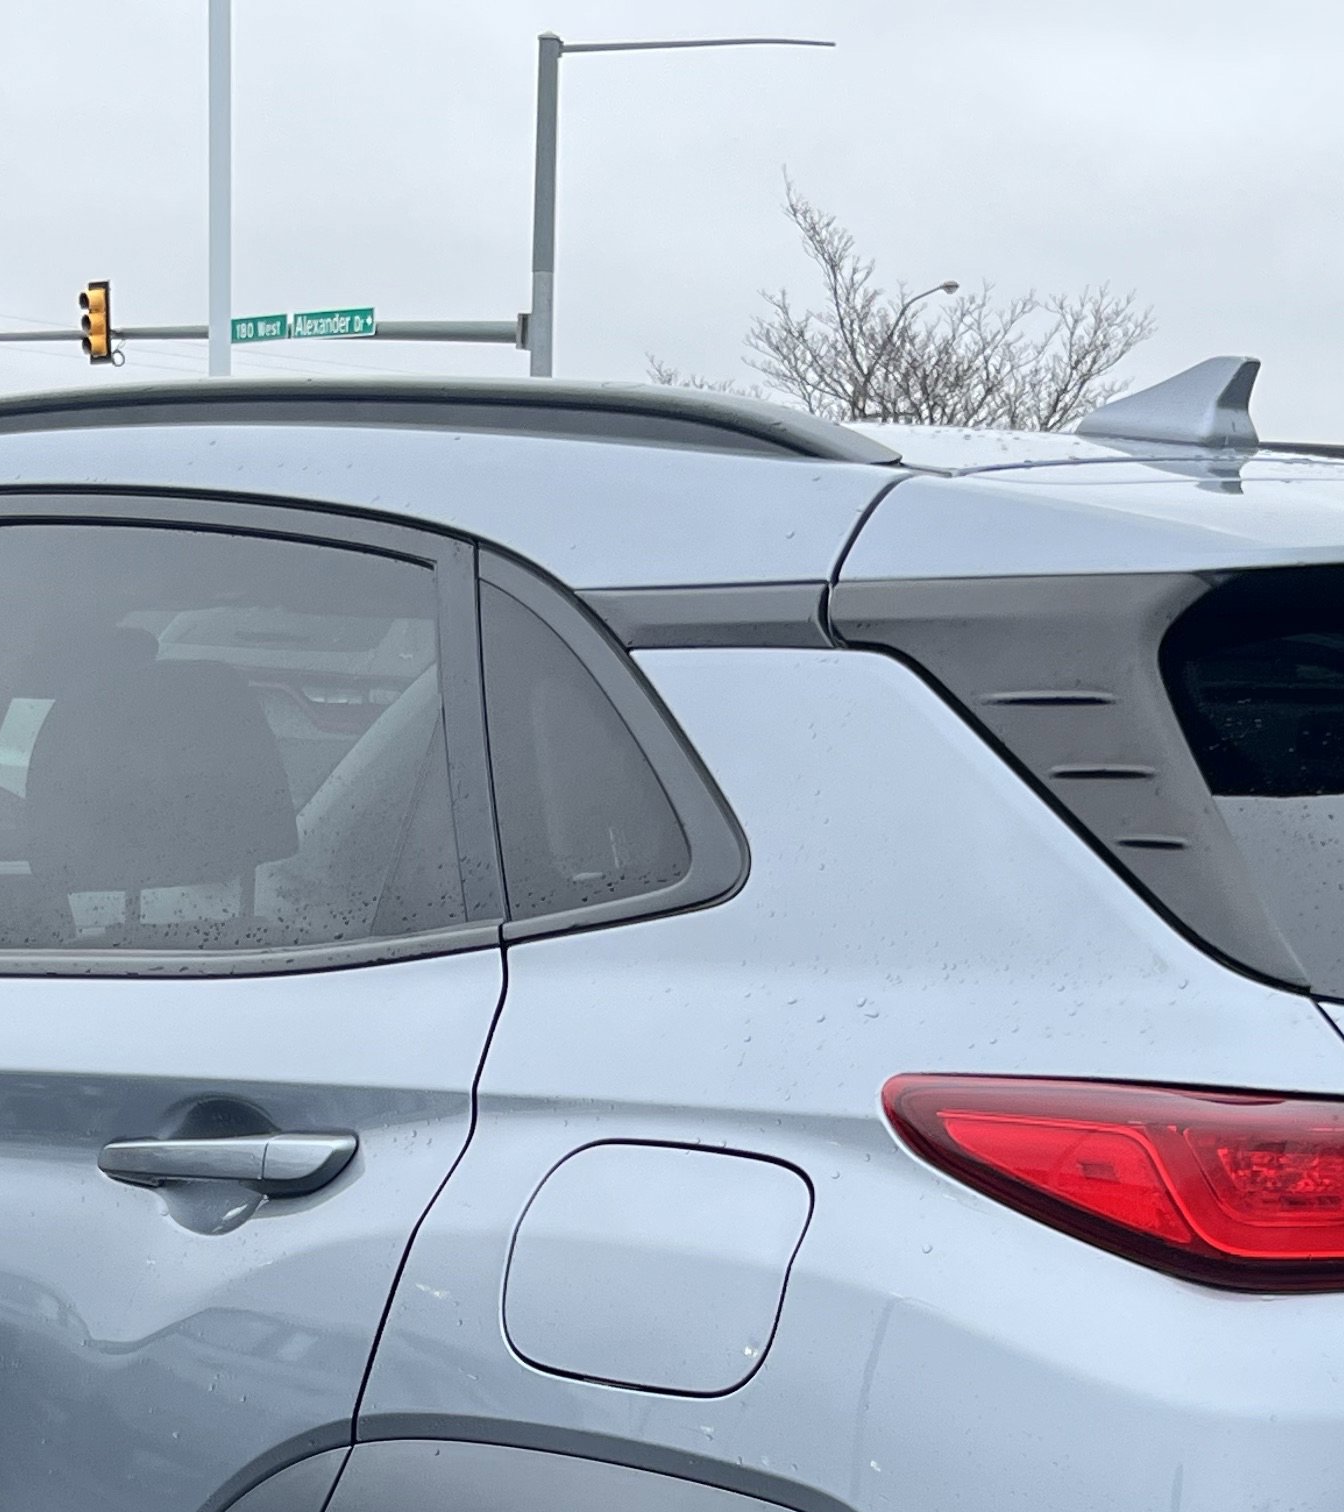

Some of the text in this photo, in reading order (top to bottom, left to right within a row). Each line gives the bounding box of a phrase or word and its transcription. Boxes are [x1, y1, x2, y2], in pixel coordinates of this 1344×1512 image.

[236, 321, 282, 340] 180 West
[294, 313, 351, 336] Alexander
